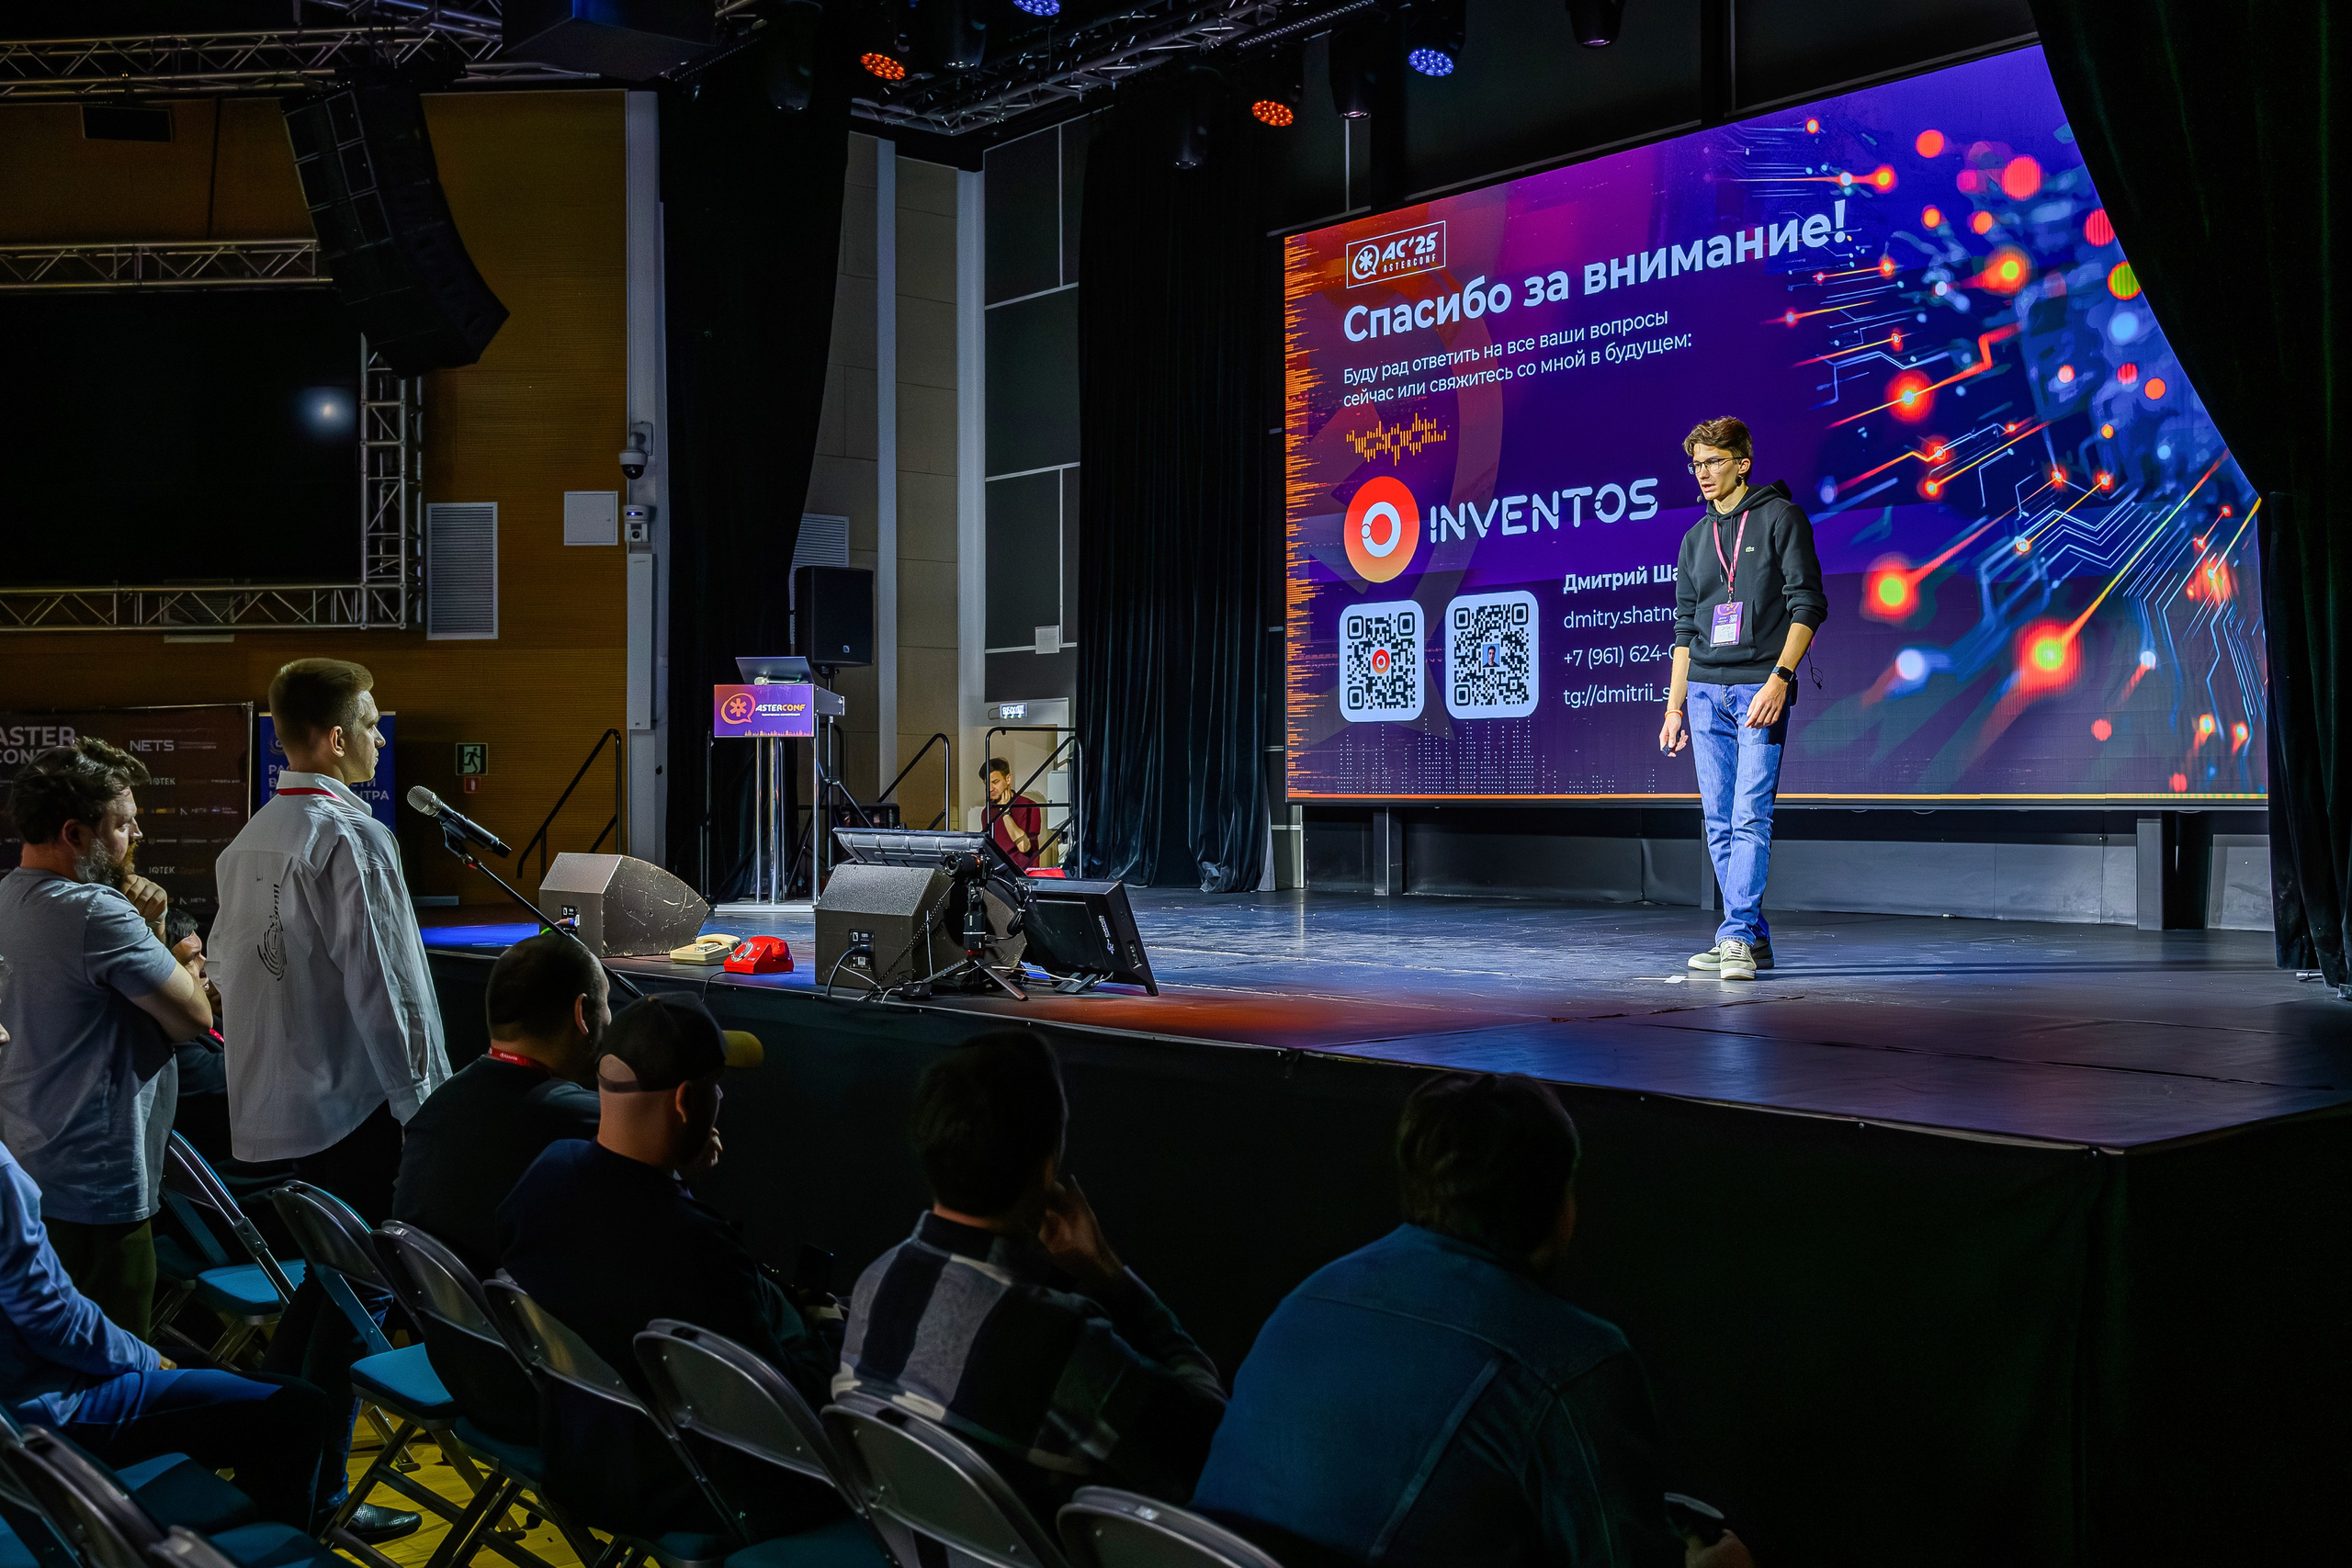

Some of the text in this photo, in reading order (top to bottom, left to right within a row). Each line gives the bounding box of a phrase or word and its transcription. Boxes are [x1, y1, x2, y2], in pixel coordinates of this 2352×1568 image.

[1344, 199, 1846, 343] Спасибо за внимание!
[1383, 254, 1436, 274] ASTERCONF
[1343, 310, 1668, 387] Буду рад ответить на все ваши вопросы
[1343, 333, 1692, 408] сейчас или свяжитесь со мной в будущем:
[1430, 478, 1658, 544] INVENTOS
[1563, 566, 1647, 594] Дмитрий
[1564, 649, 1583, 667] +7
[1588, 645, 1624, 670] (961)
[755, 704, 806, 712] ASTERCONF
[130, 739, 175, 751] NETS
